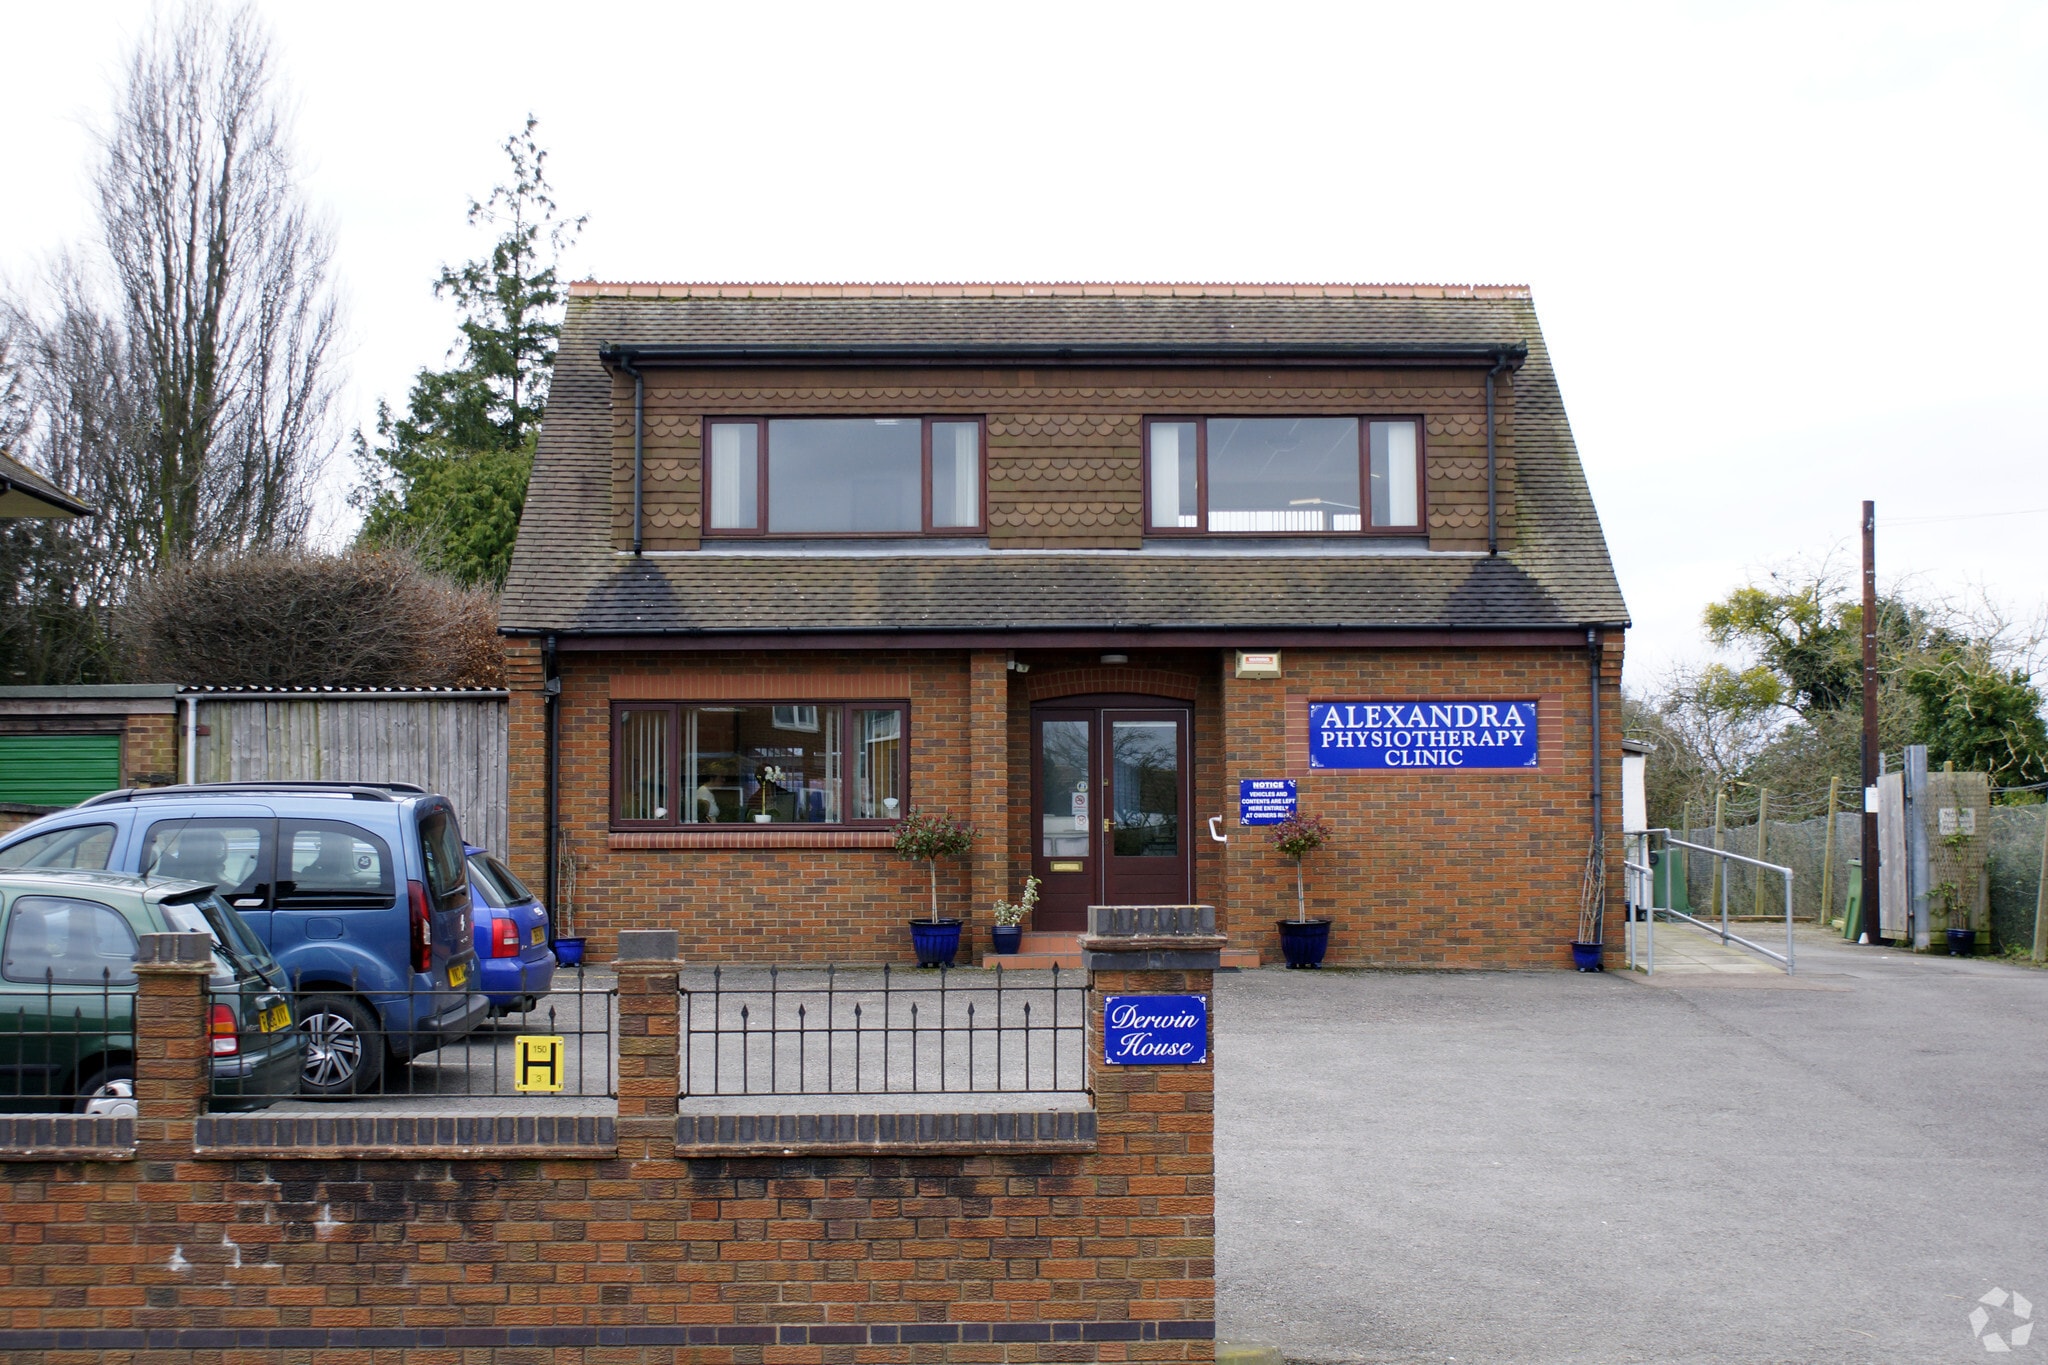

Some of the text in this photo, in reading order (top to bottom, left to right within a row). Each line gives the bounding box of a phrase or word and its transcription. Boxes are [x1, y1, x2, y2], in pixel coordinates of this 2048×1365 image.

[1321, 704, 1526, 729] ALEXANDRA
[1321, 730, 1526, 748] PHYSIOTHERAPY
[1384, 749, 1464, 766] CLINIC
[1111, 1004, 1200, 1029] Derwin
[533, 1045, 547, 1053] 150
[1116, 1032, 1195, 1057] House
[522, 1042, 556, 1085] H
[536, 1074, 542, 1082] 3
